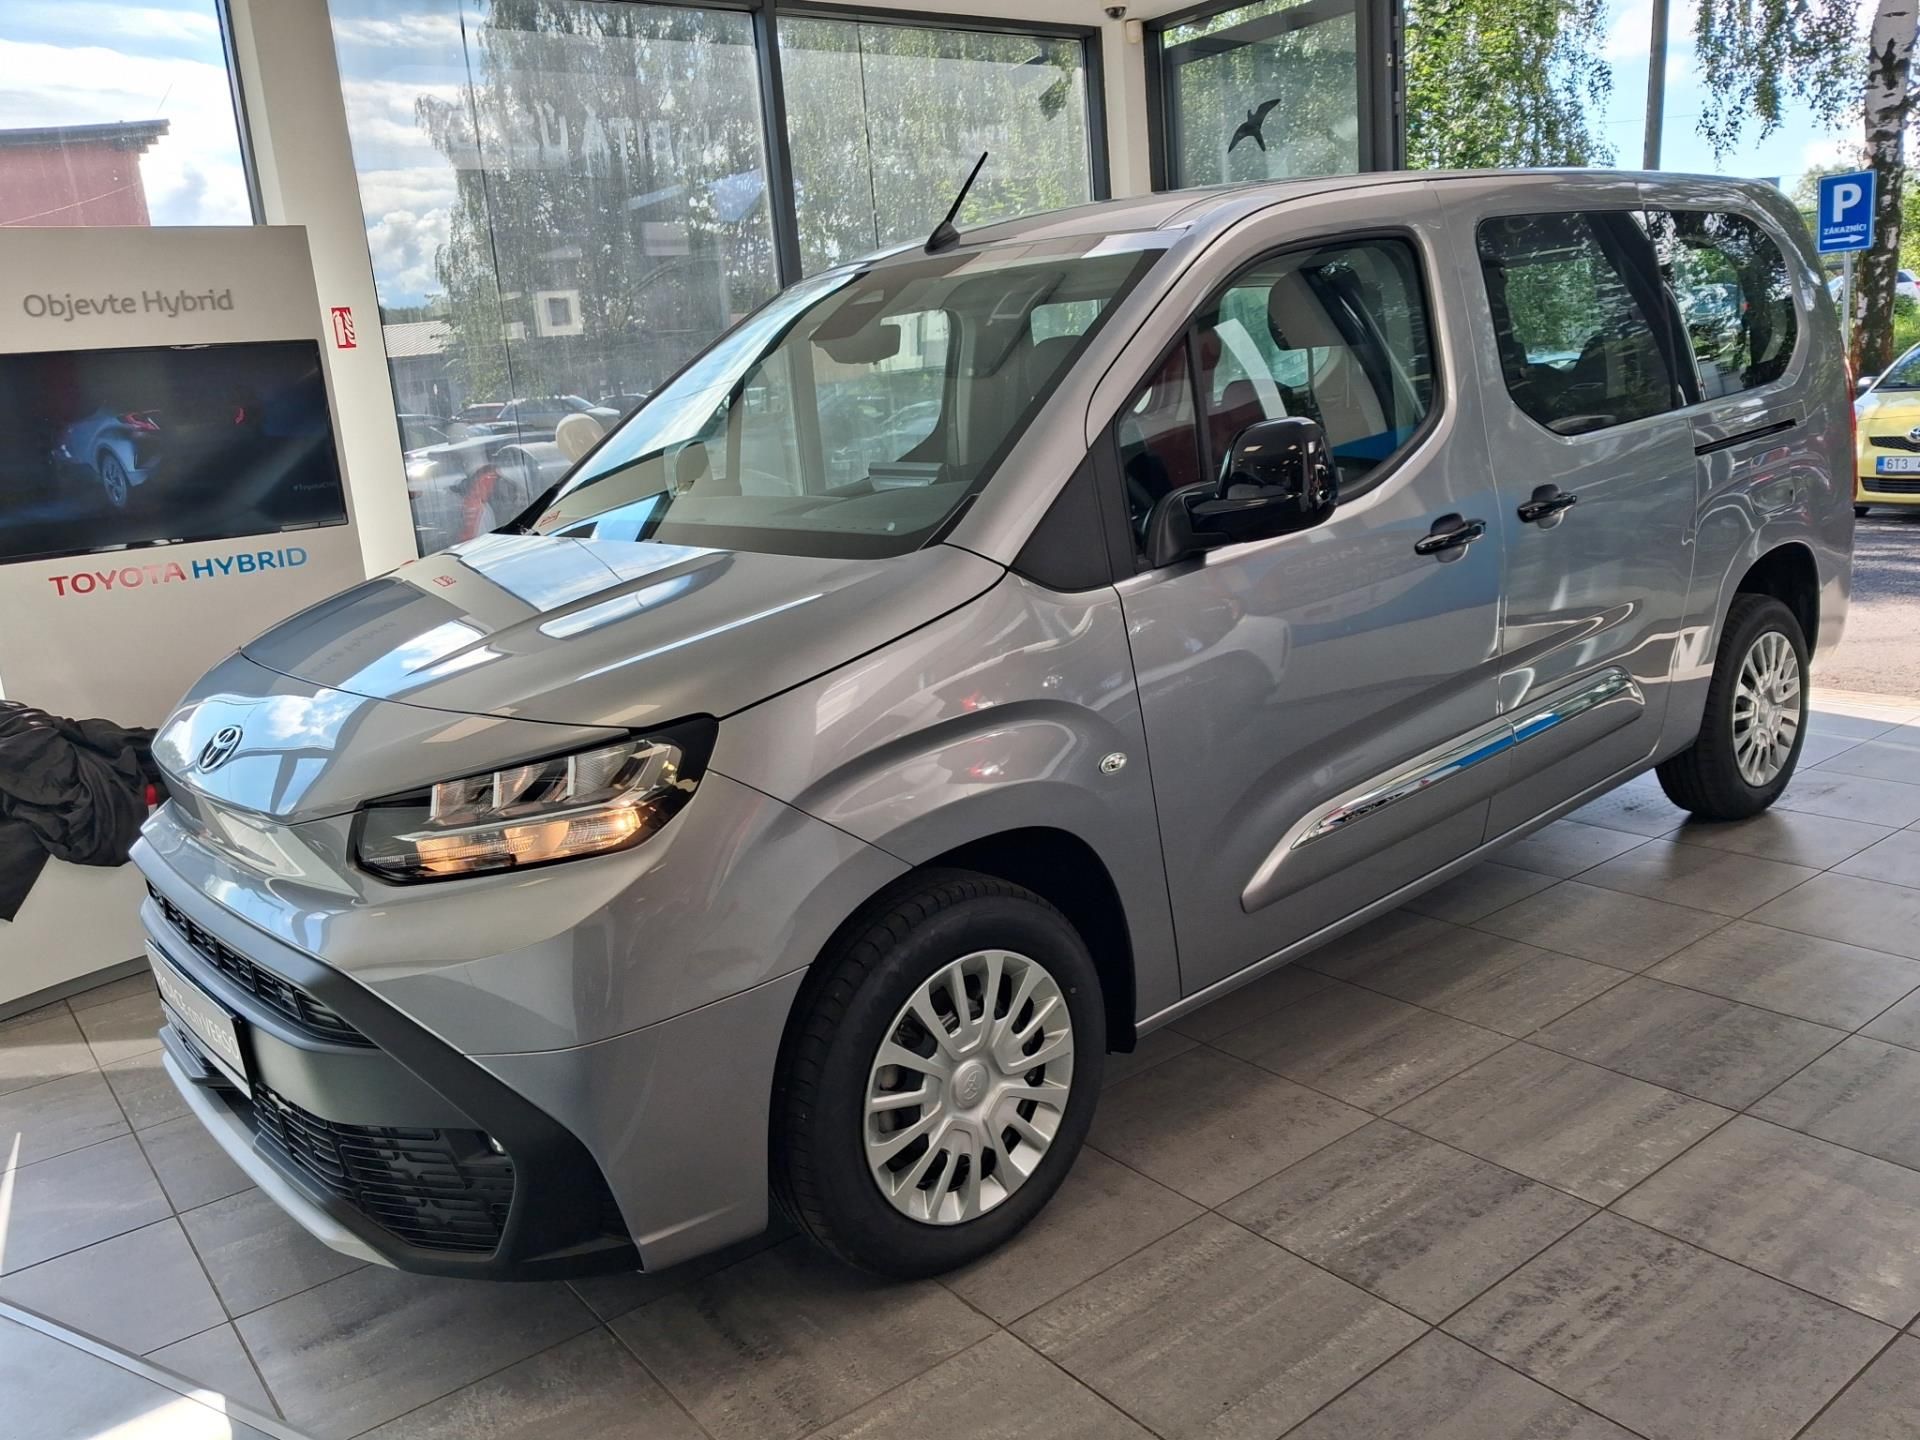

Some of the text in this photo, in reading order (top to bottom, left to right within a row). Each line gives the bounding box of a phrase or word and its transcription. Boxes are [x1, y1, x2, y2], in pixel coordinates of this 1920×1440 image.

[1833, 183, 1862, 223] P
[1823, 222, 1867, 235] ZÁKAZNÍCI
[23, 289, 234, 322] Objevte Hybrid
[48, 547, 309, 597] TOYOTA HYBRID
